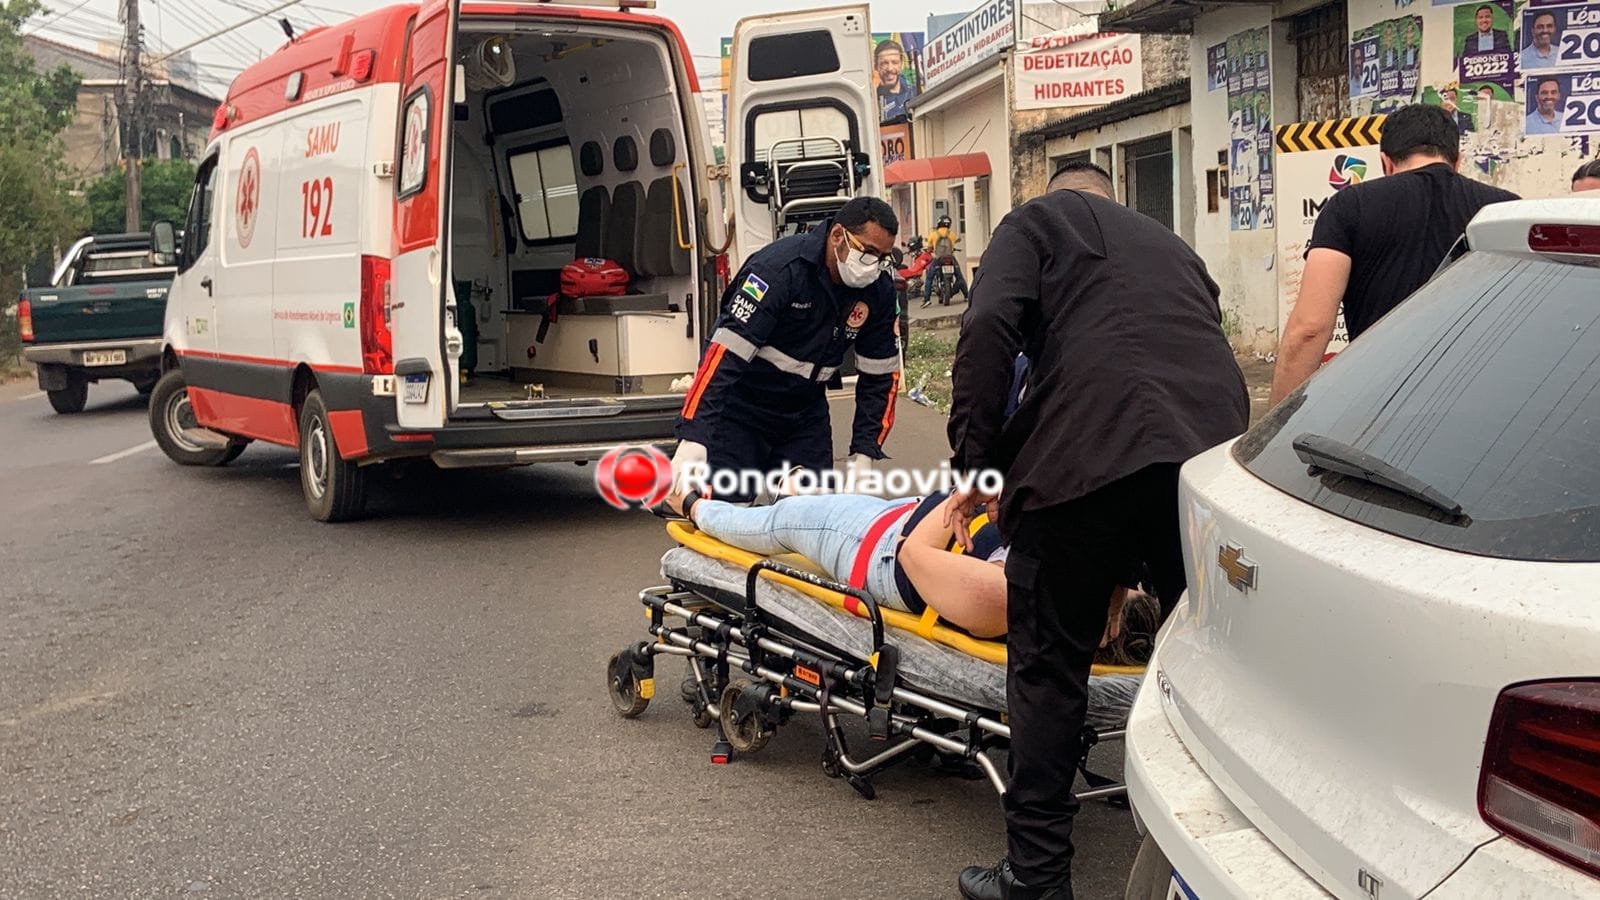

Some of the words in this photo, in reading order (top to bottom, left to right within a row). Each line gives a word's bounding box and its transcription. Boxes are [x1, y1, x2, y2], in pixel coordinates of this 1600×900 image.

[945, 0, 1013, 54] EXTINTORES
[974, 21, 1014, 53] HIDRANTES
[1023, 46, 1133, 71] DEDETIZAÇÃO
[1561, 32, 1600, 60] 20
[1464, 56, 1489, 65] PEDRO
[1489, 54, 1509, 62] NETO
[1465, 61, 1508, 77] 20222
[1363, 64, 1379, 89] 20
[1034, 79, 1125, 100] HIDRANTES
[305, 121, 340, 158] SAMU
[303, 176, 333, 239] 192
[731, 303, 751, 324] 192
[734, 294, 757, 314] SAMU
